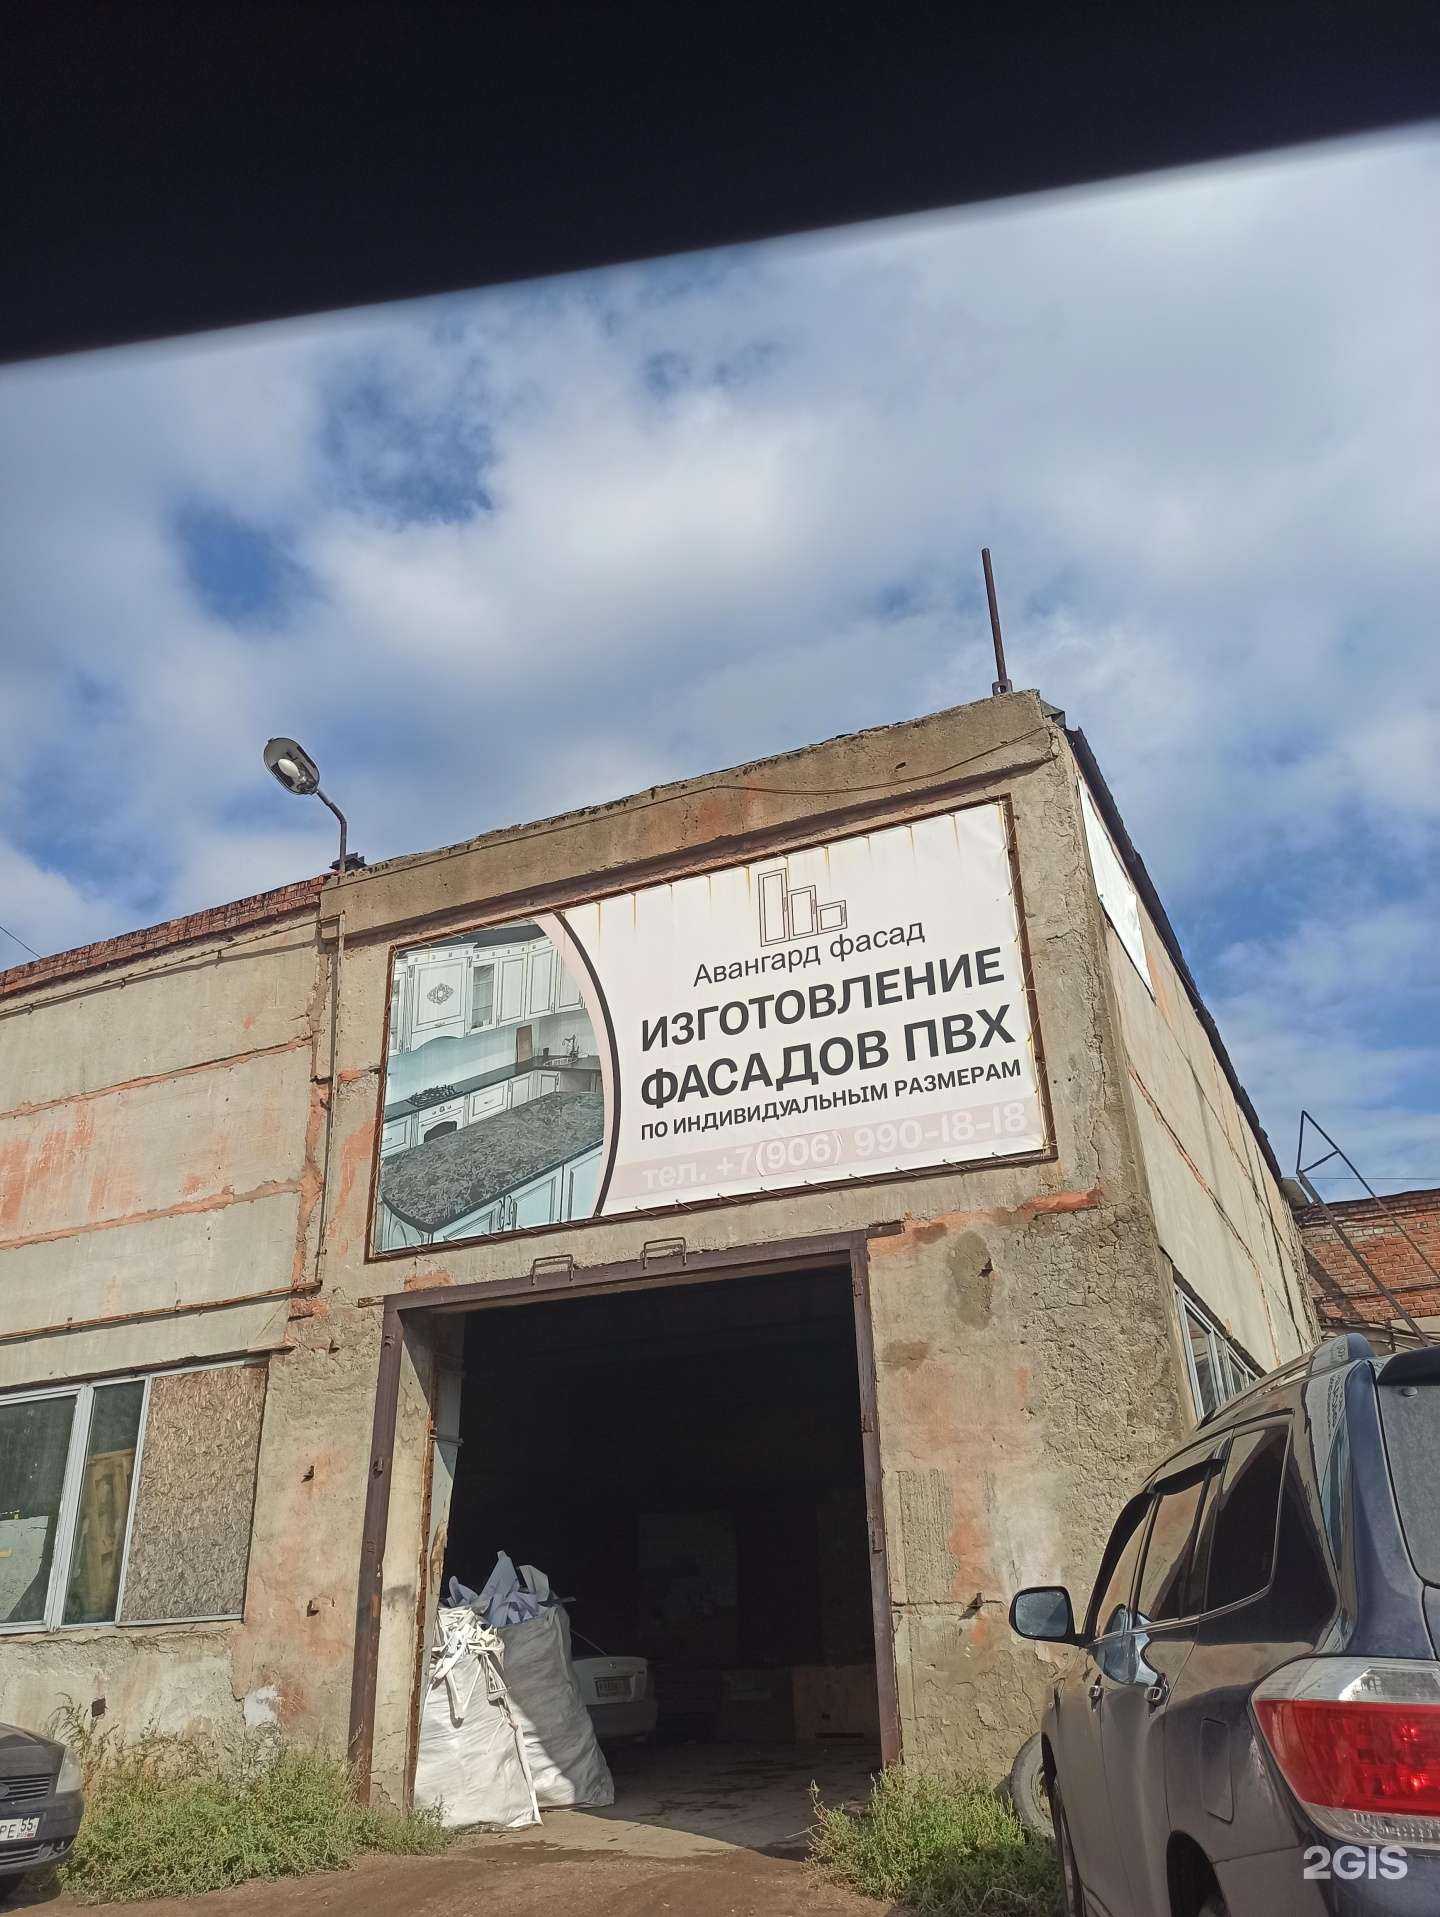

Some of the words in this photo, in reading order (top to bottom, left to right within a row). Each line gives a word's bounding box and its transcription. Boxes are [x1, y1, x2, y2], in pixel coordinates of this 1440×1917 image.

[693, 942, 820, 988] Авангард
[829, 921, 925, 963] фасад
[641, 946, 1006, 1052] ИЗГОТОВЛЕНИЕ
[641, 1030, 889, 1110] ФАСАДОВ
[903, 1003, 1016, 1062] ПВХ
[641, 1120, 669, 1141] ПО
[673, 1082, 888, 1135] ИНДИВИДУАЛЬНЫМ
[894, 1058, 1021, 1098] РАЗМЕРАМ
[642, 1162, 706, 1188] тел.
[716, 1130, 843, 1177] +7(906)
[854, 1102, 1027, 1156] 990-18-18
